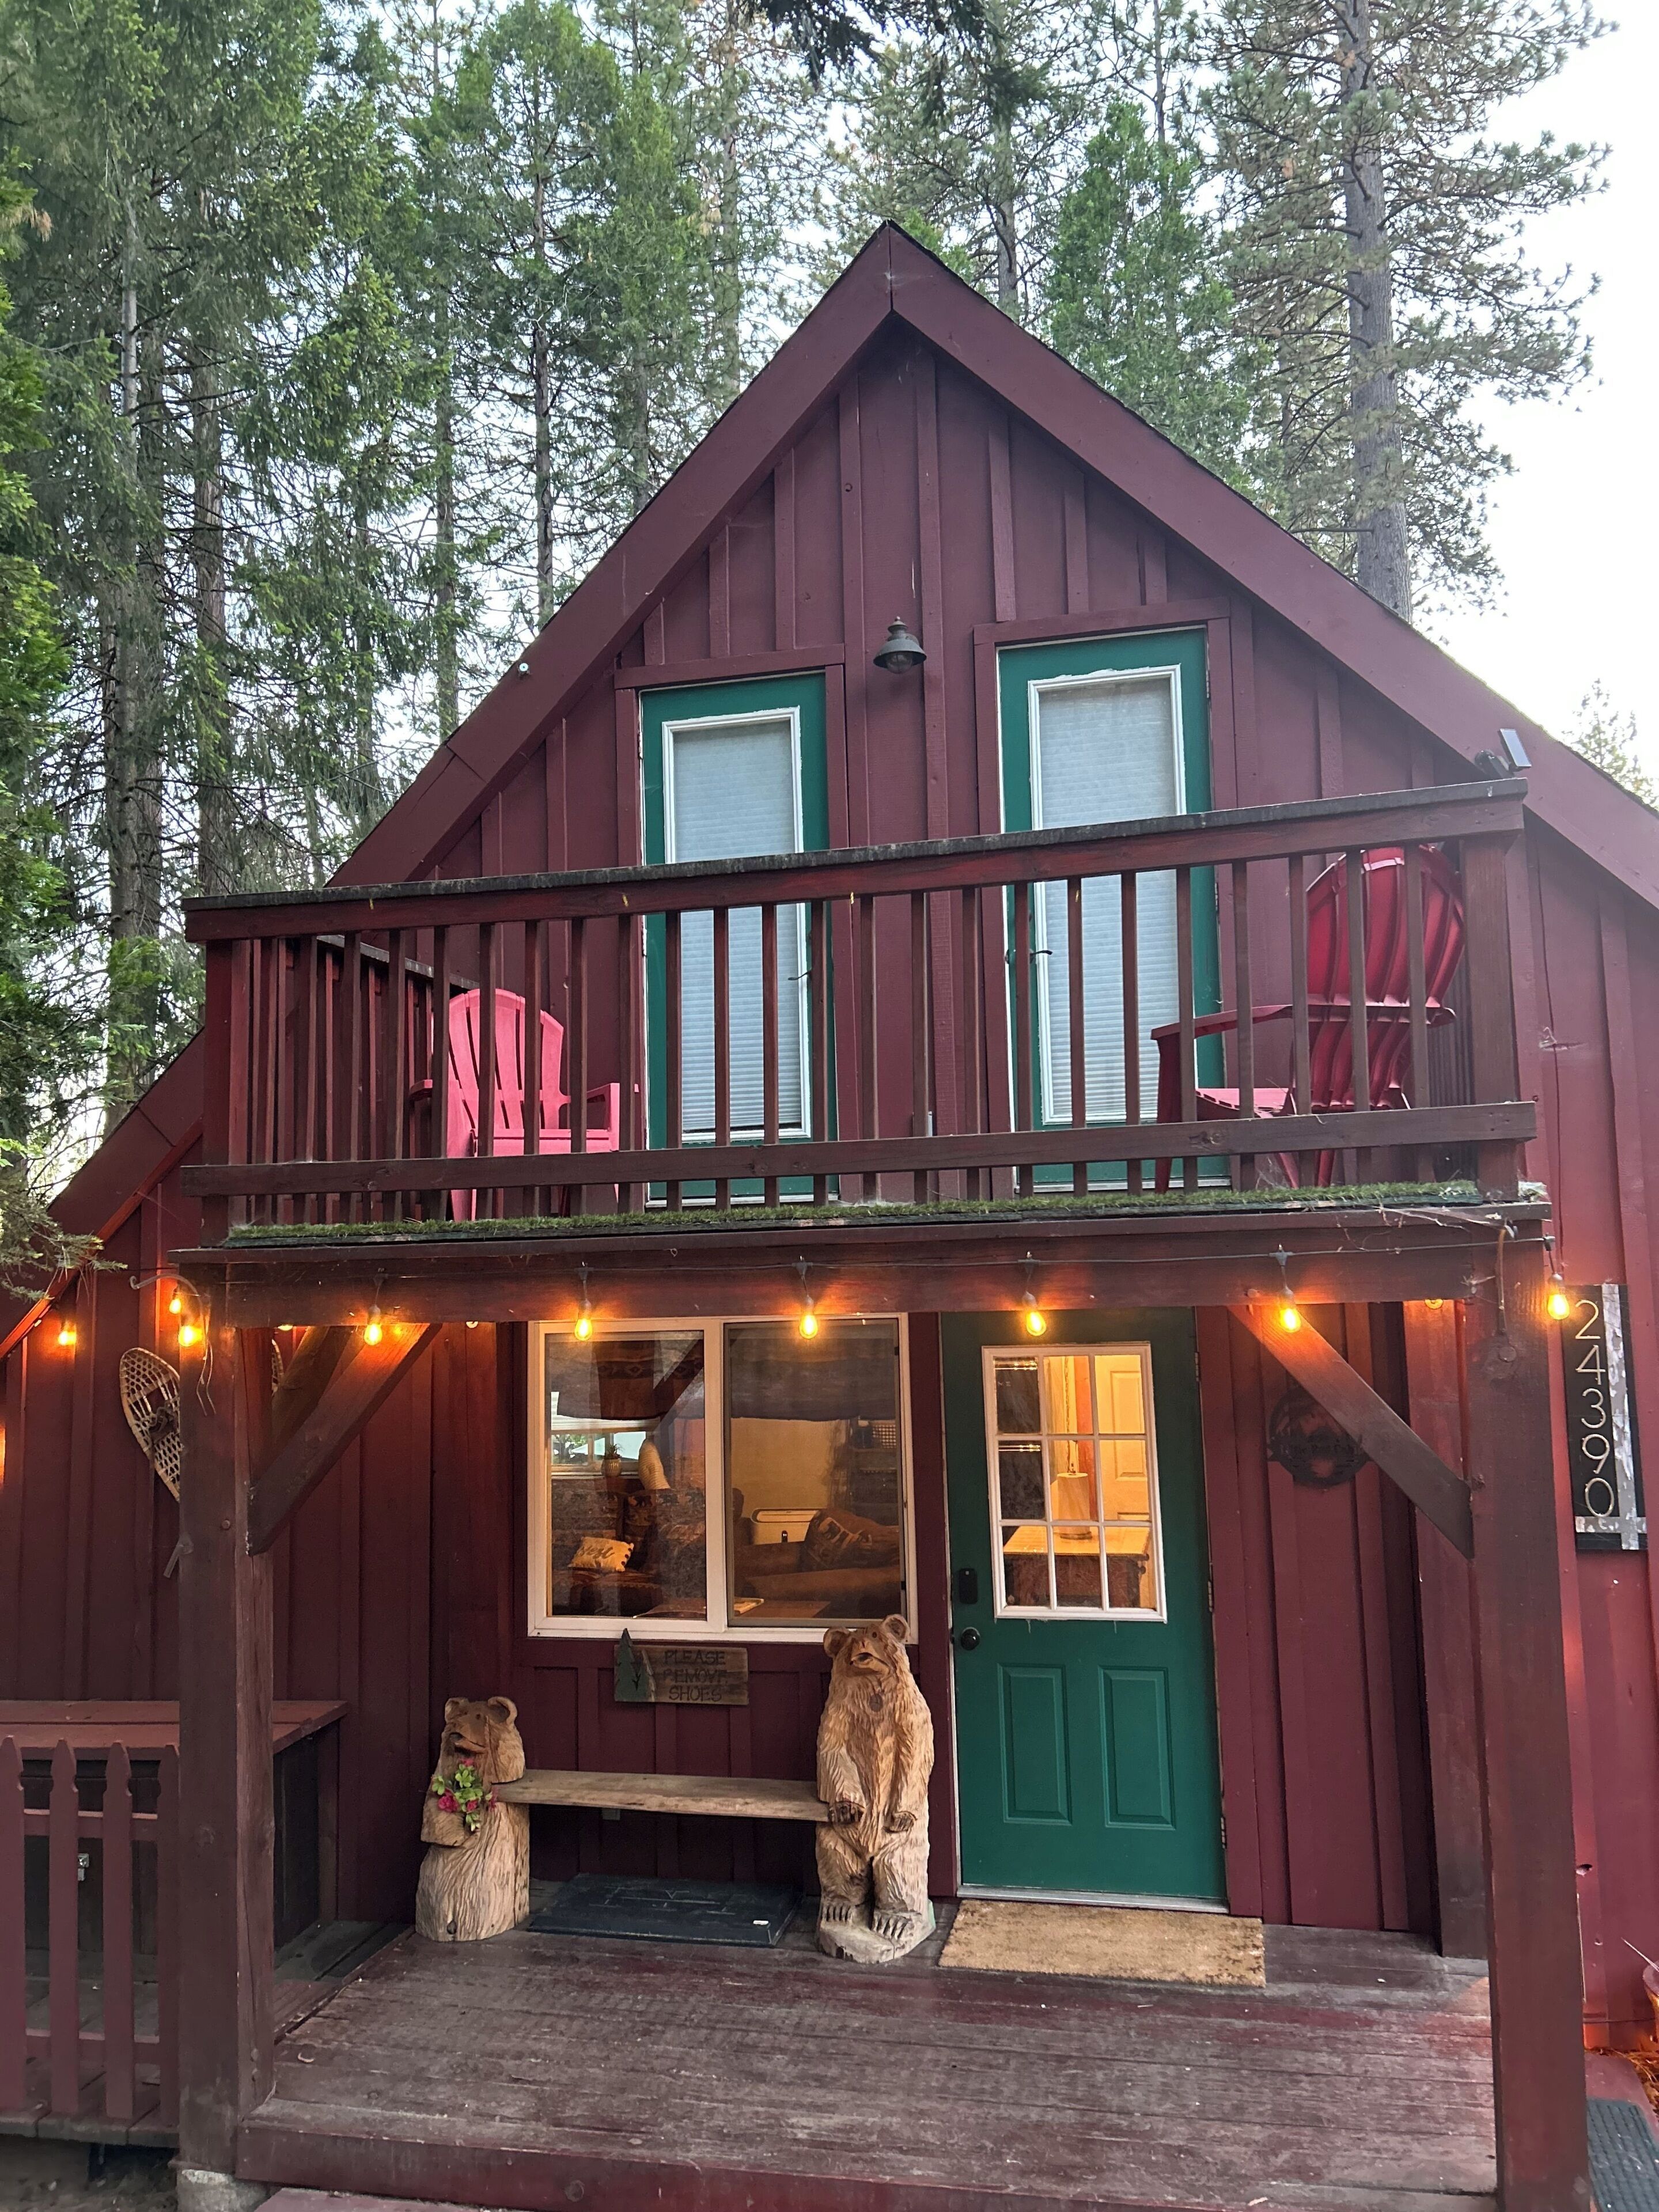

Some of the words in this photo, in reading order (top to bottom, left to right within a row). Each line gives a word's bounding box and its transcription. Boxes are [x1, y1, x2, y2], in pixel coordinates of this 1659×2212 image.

[1575, 1300, 1614, 1517] 24390
[664, 1649, 726, 1666] PLEASE
[664, 1668, 727, 1683] REMOVE
[669, 1685, 722, 1702] SHOES
